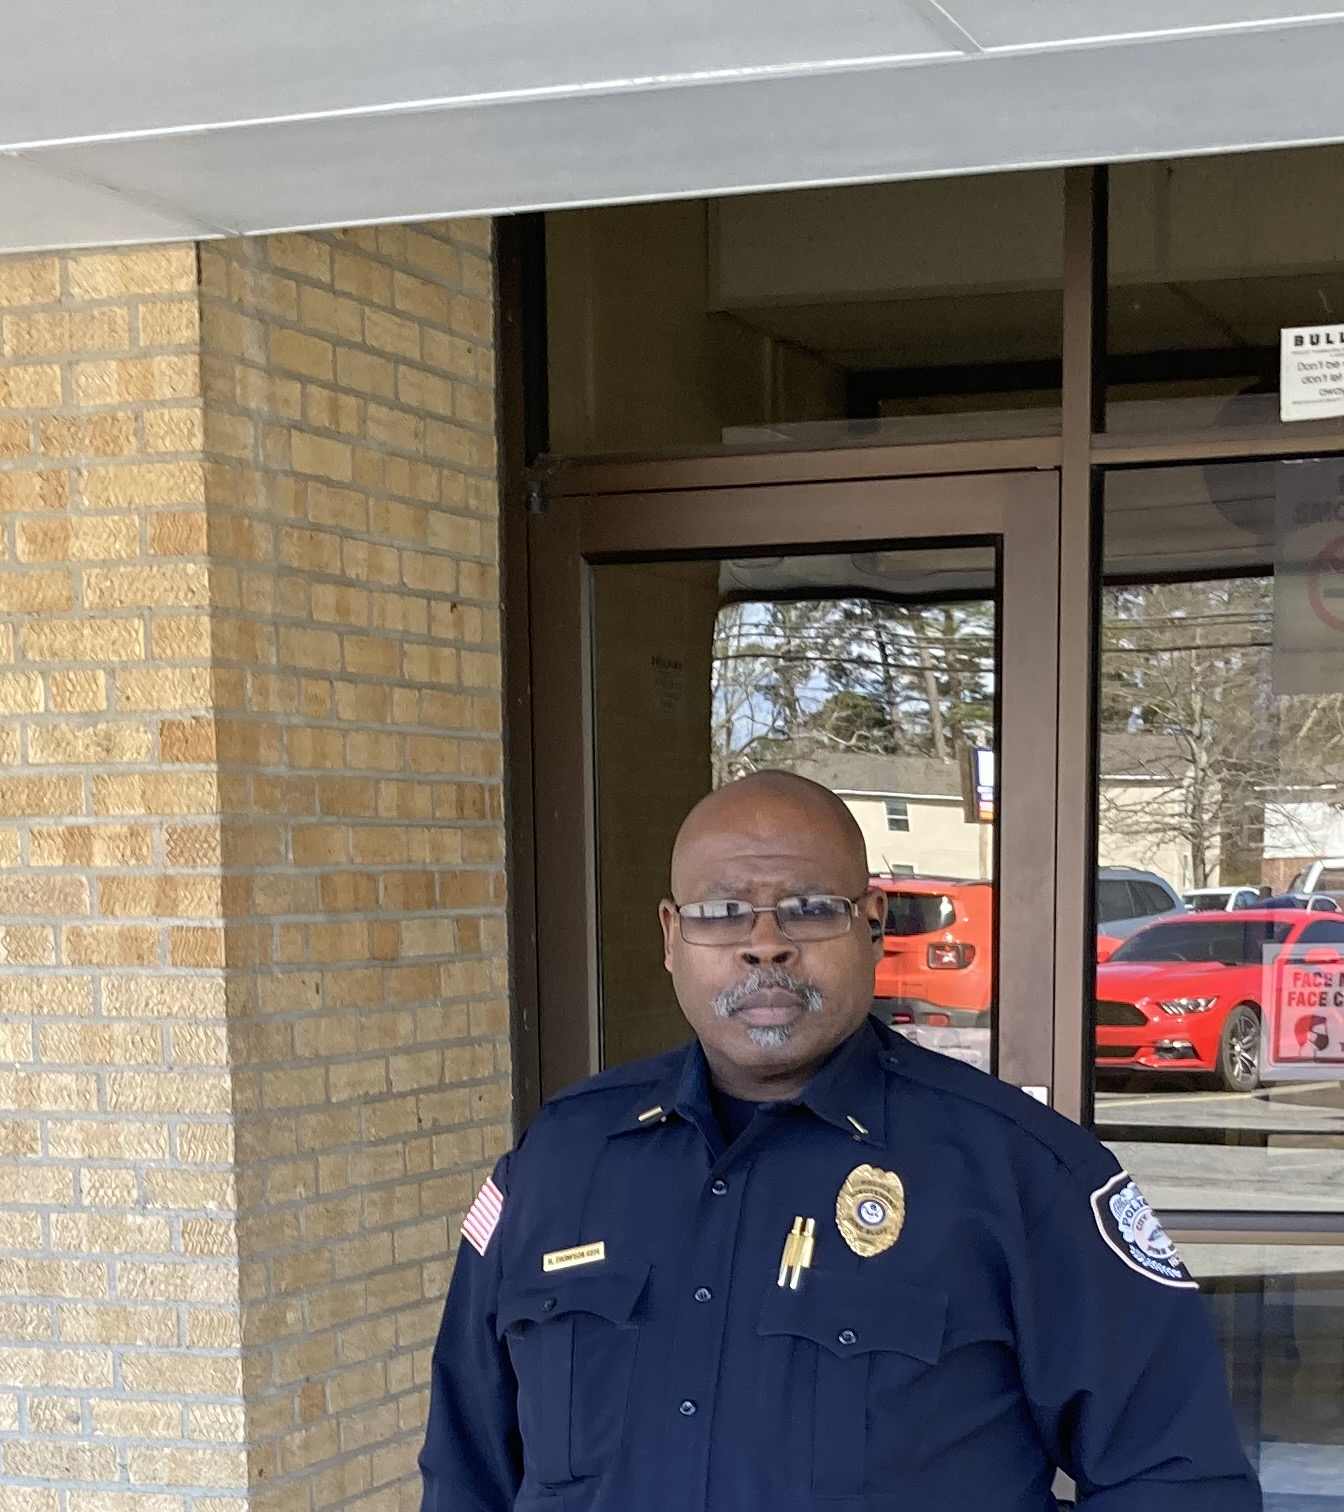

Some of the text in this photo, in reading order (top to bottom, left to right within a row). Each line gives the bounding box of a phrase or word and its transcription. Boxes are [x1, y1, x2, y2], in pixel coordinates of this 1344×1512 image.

[1297, 361, 1324, 372] Don't
[1325, 360, 1340, 370] be
[1301, 374, 1328, 385] don't
[1329, 373, 1343, 382] let
[1293, 971, 1333, 988] FACE
[1287, 991, 1327, 1007] FACE
[1122, 1197, 1149, 1228] POLIC
[1136, 1214, 1148, 1231] CITY
